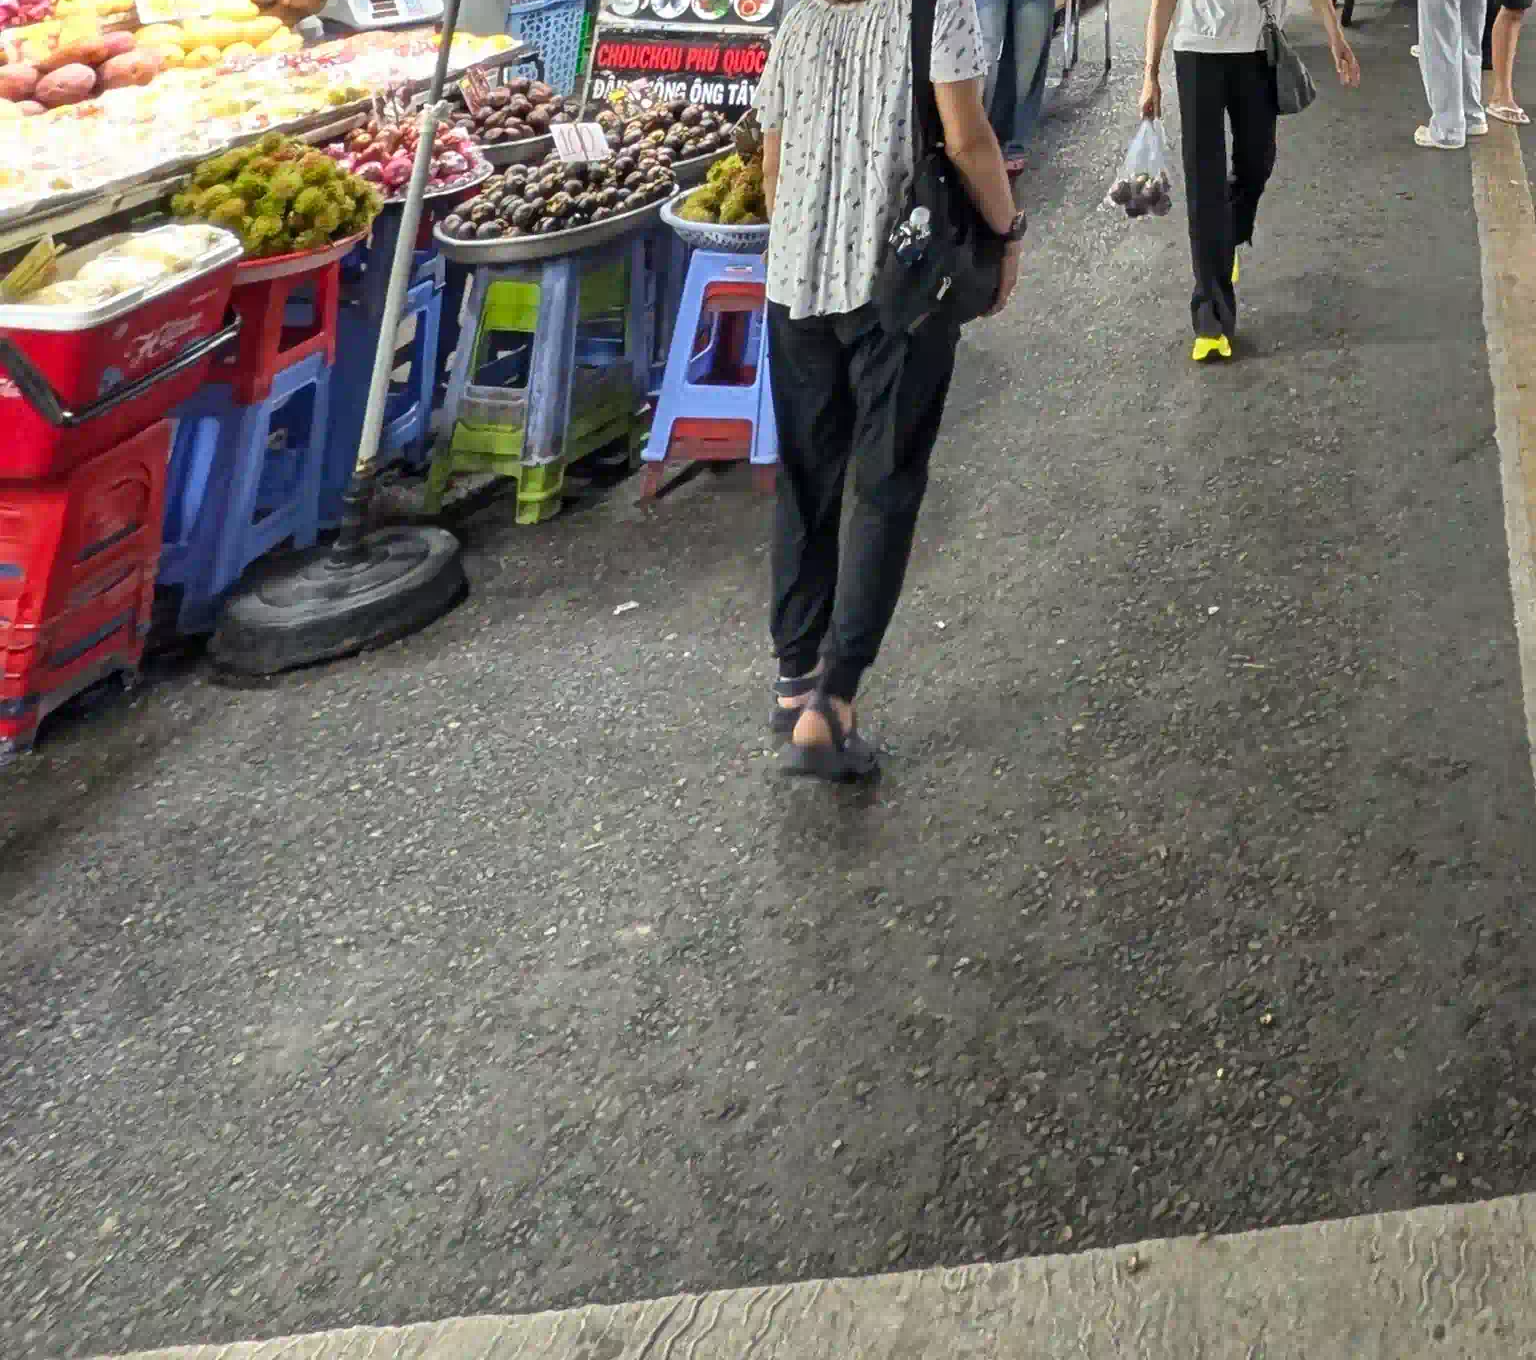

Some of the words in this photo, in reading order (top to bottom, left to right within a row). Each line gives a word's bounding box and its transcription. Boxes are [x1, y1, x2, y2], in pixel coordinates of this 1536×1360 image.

[597, 43, 682, 72] CHOUCHOU
[685, 42, 720, 72] PHÚ
[722, 43, 767, 78] QUỐC
[689, 78, 724, 106] ÔNG
